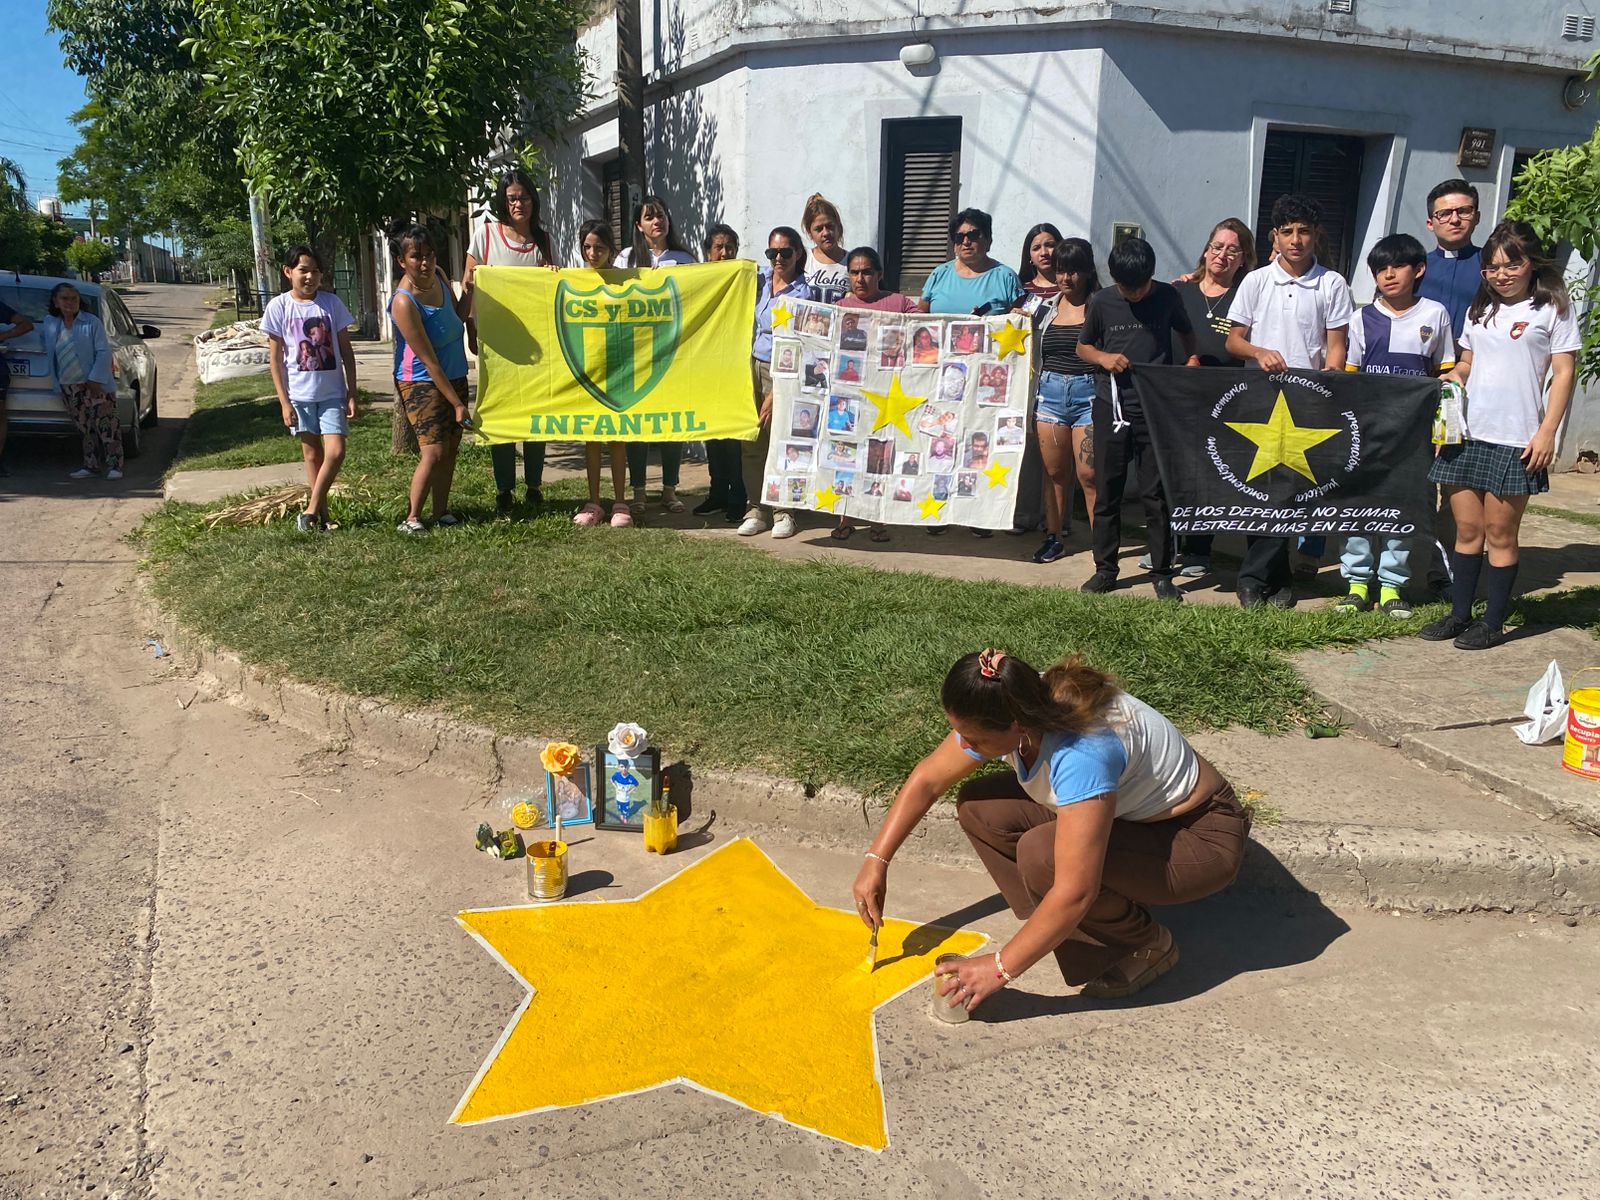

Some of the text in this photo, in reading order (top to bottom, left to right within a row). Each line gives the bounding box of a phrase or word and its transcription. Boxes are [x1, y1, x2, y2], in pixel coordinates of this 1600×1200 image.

[805, 269, 849, 287] Aloha
[565, 299, 672, 322] CS y DM
[1268, 372, 1333, 398] educación
[1210, 381, 1249, 419] memoria
[530, 411, 706, 435] INFANTIL
[1340, 410, 1361, 473] prevención
[1171, 505, 1401, 520] DE VOS DEPENDE, NO SUMAR
[1170, 519, 1416, 535] NA ESTRELLA MAS EN EL CIELO
